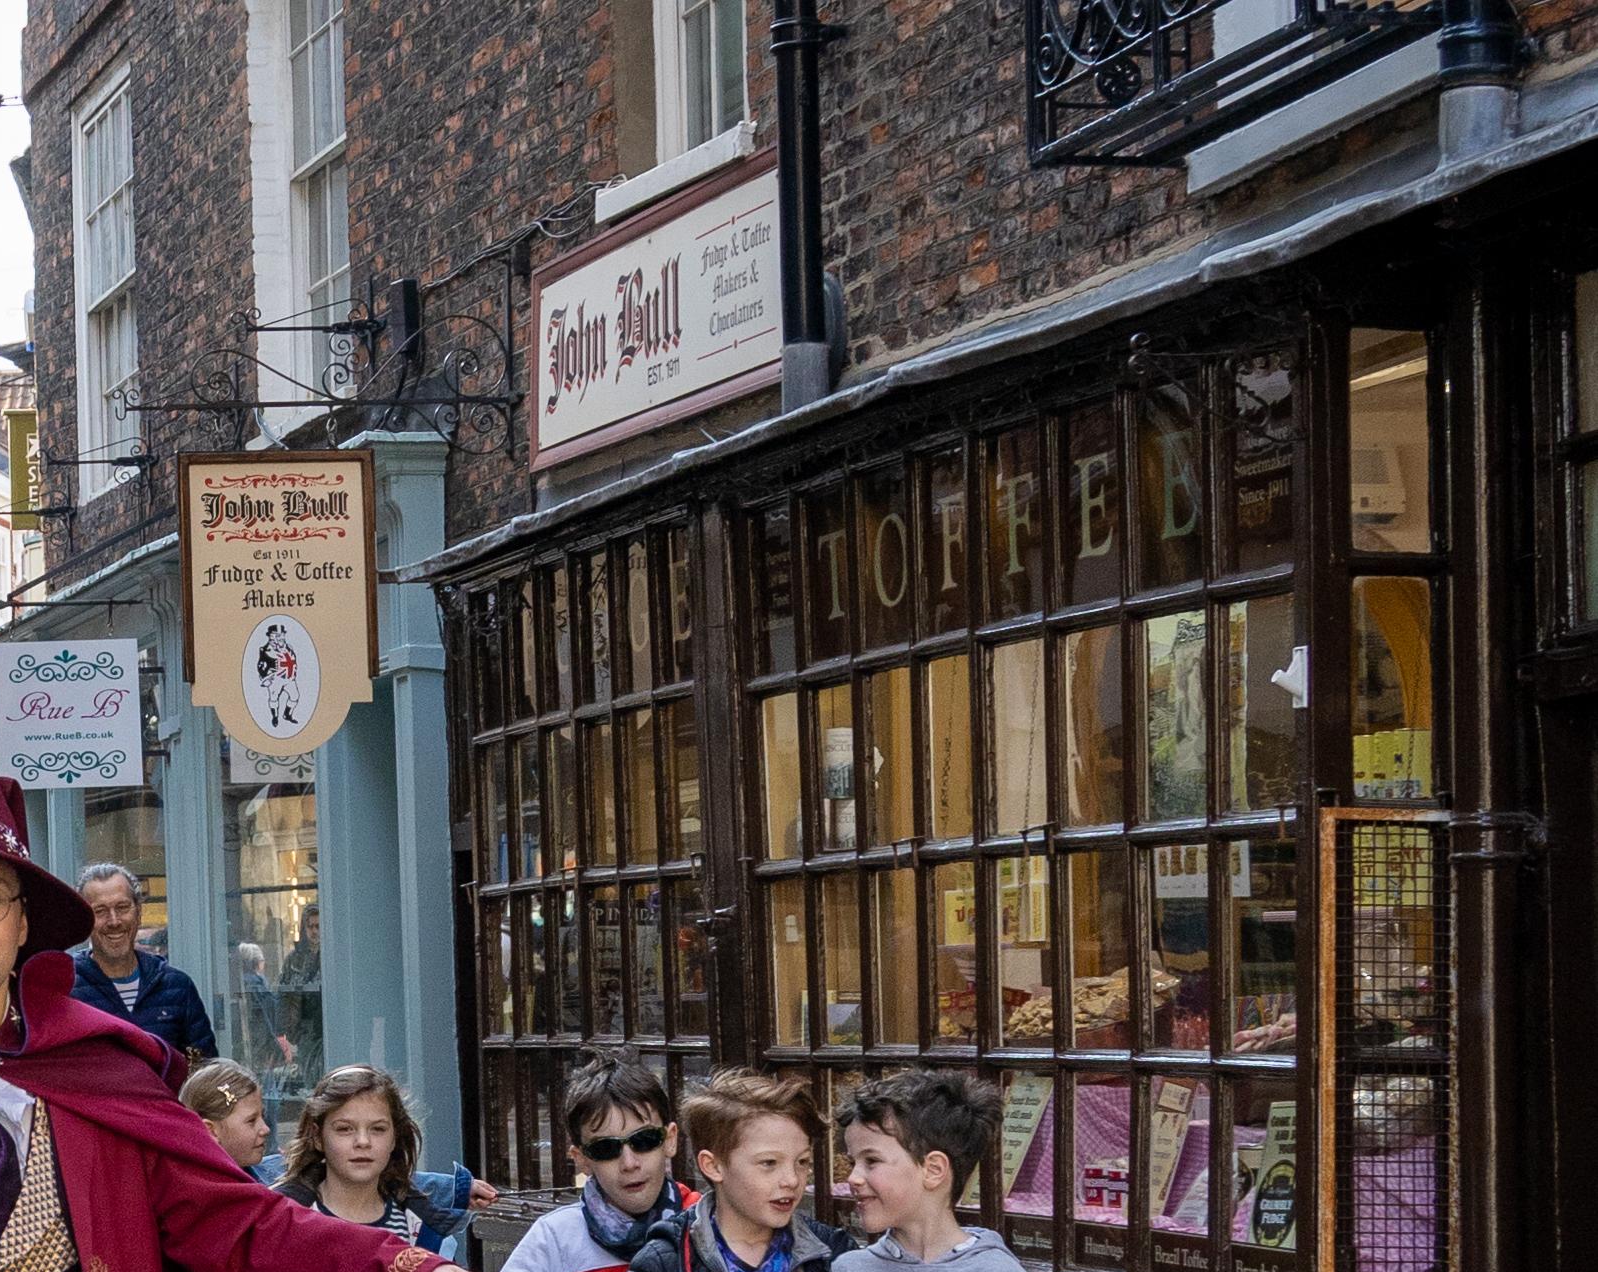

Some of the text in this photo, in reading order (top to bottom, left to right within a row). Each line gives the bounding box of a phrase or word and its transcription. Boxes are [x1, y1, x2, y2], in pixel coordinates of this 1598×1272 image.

[701, 220, 772, 276] Fudge & Toffee
[713, 259, 760, 303] Makers &
[709, 295, 764, 337] Chocolatiers
[545, 252, 684, 417] John Bull
[647, 355, 681, 386] EST. 1911
[1267, 477, 1290, 500] 1911
[201, 490, 351, 528] John Bull
[817, 429, 1202, 621] TOFFEE
[253, 549, 301, 560] Est 1911
[202, 561, 353, 588] Fudge & Toffee
[241, 589, 315, 611] Makers
[6, 688, 130, 721] Rue B
[24, 731, 114, 741] www.RueB.co.uk
[1261, 1212, 1288, 1224] FUDGE
[1154, 1245, 1180, 1266] Brazil
